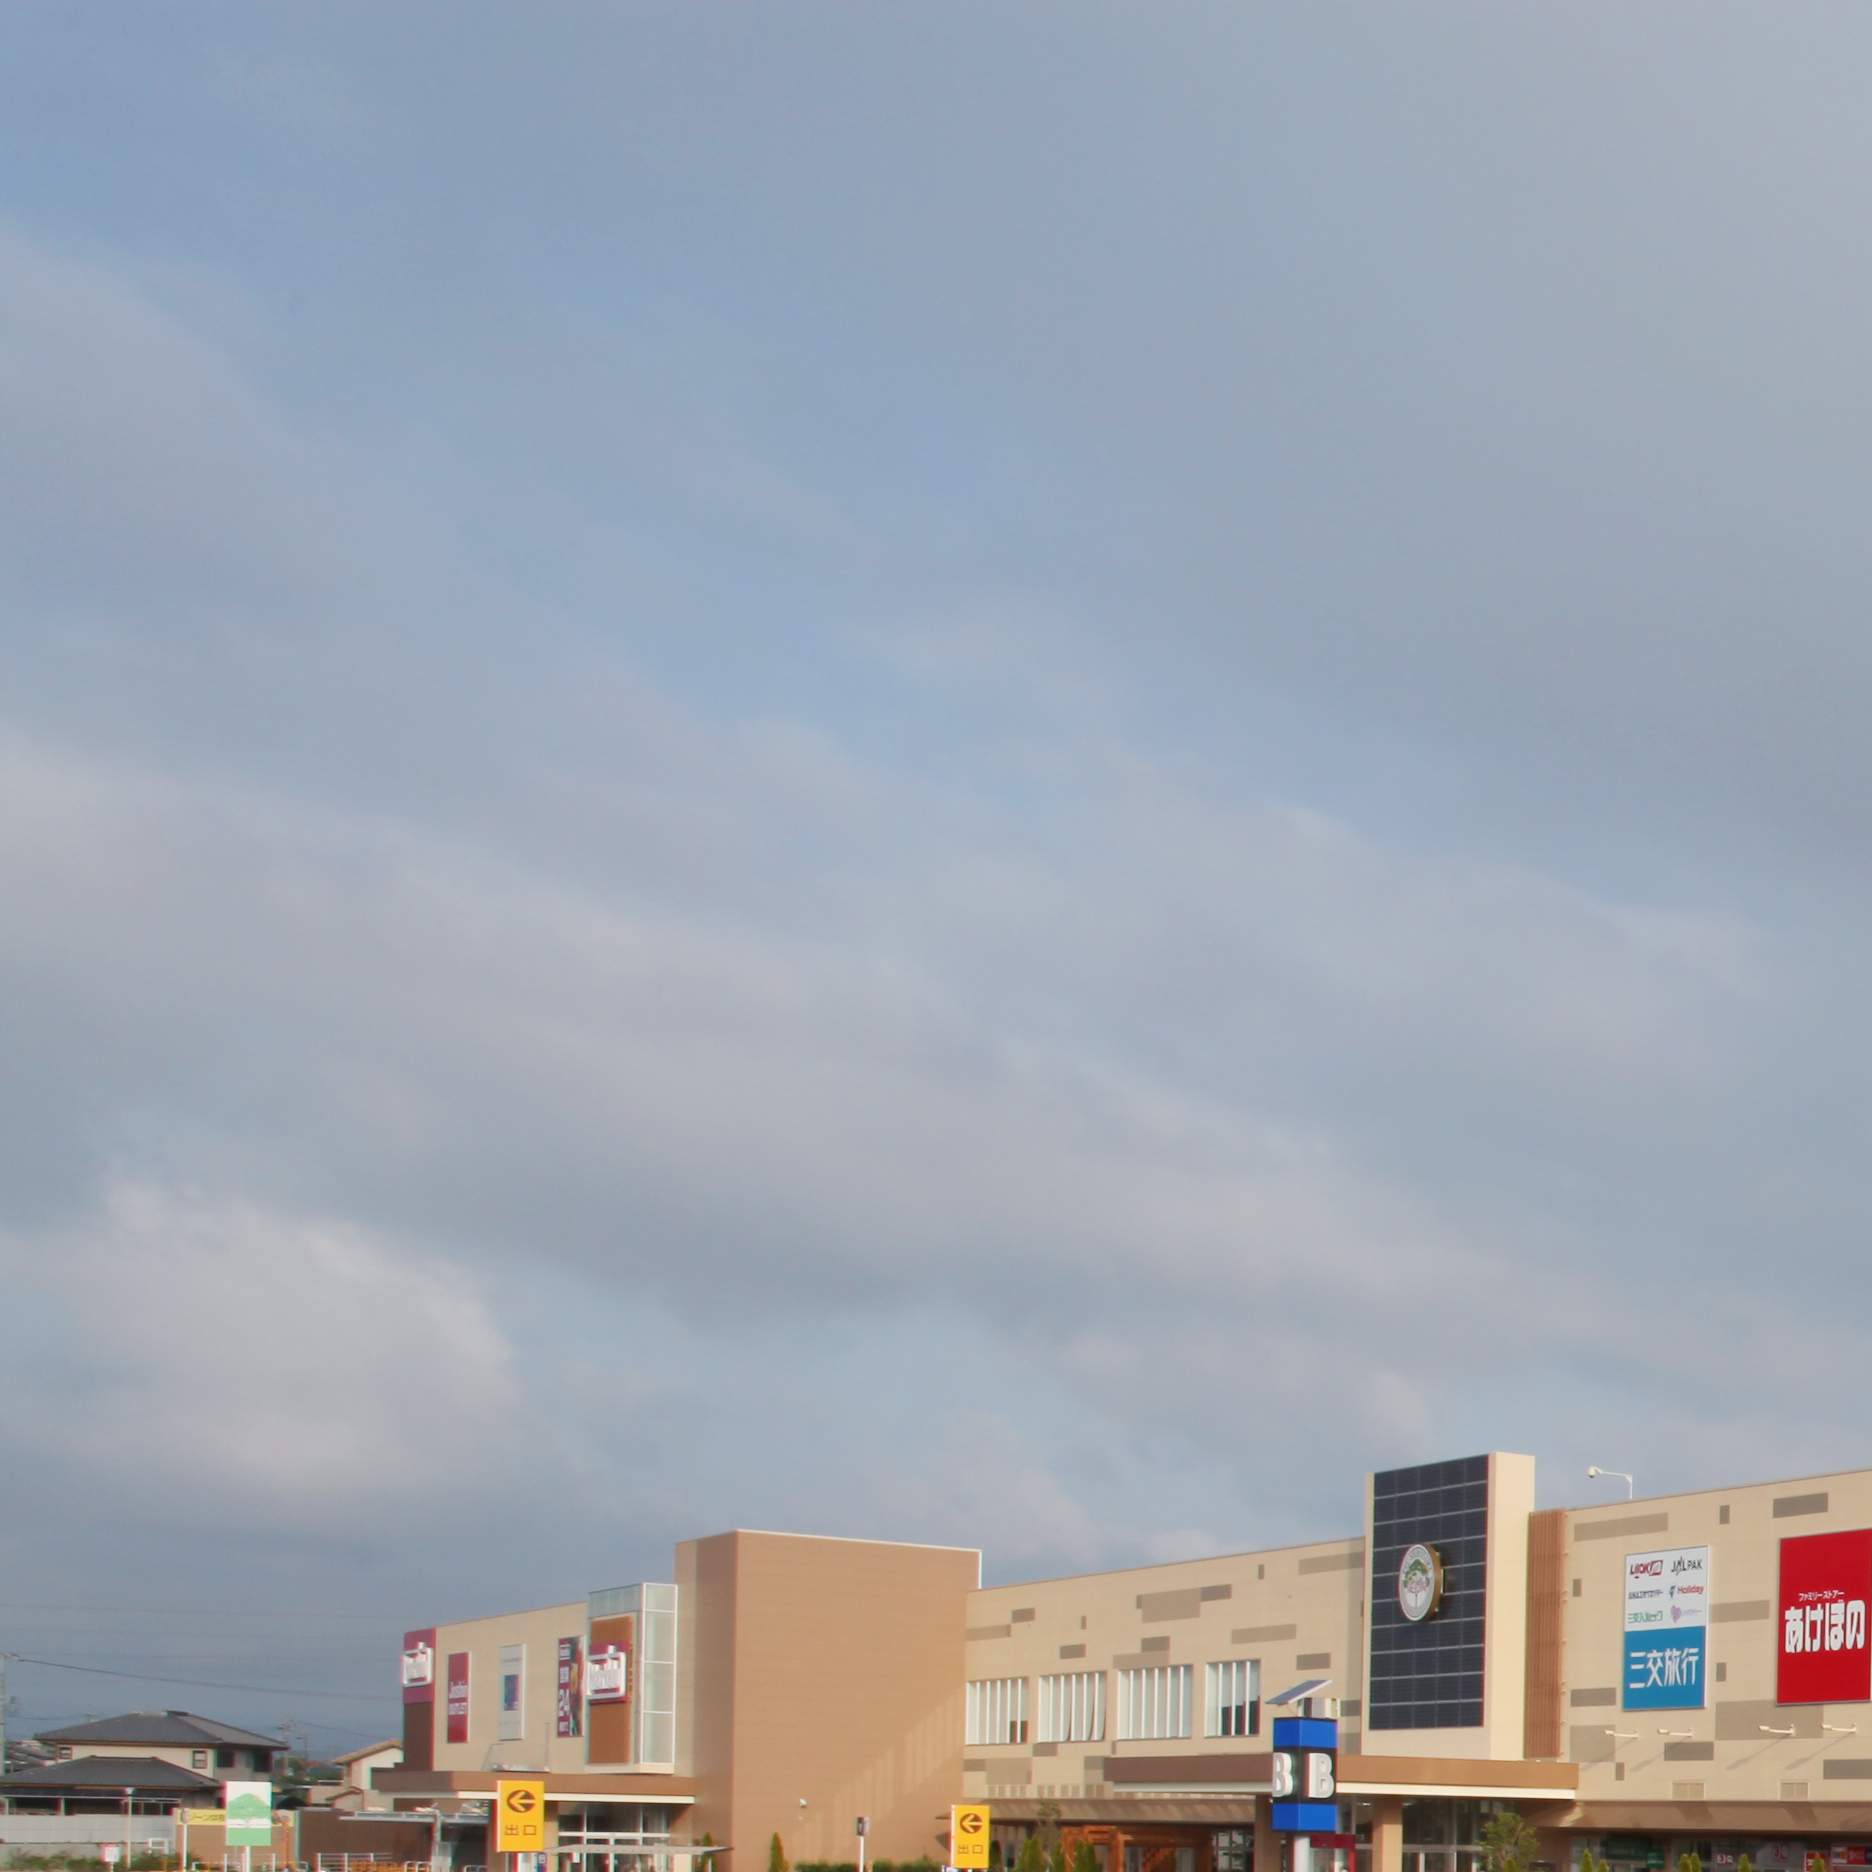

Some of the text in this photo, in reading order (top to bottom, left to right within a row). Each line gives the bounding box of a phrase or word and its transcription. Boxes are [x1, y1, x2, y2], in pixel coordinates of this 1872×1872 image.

[1785, 1600, 1865, 1653] あけぼの
[1629, 1648, 1699, 1690] 三交旅行
[1272, 1752, 1293, 1797] B
[1308, 1752, 1335, 1798] B
[505, 1823, 538, 1837] 出口
[957, 1844, 984, 1855] 出口
